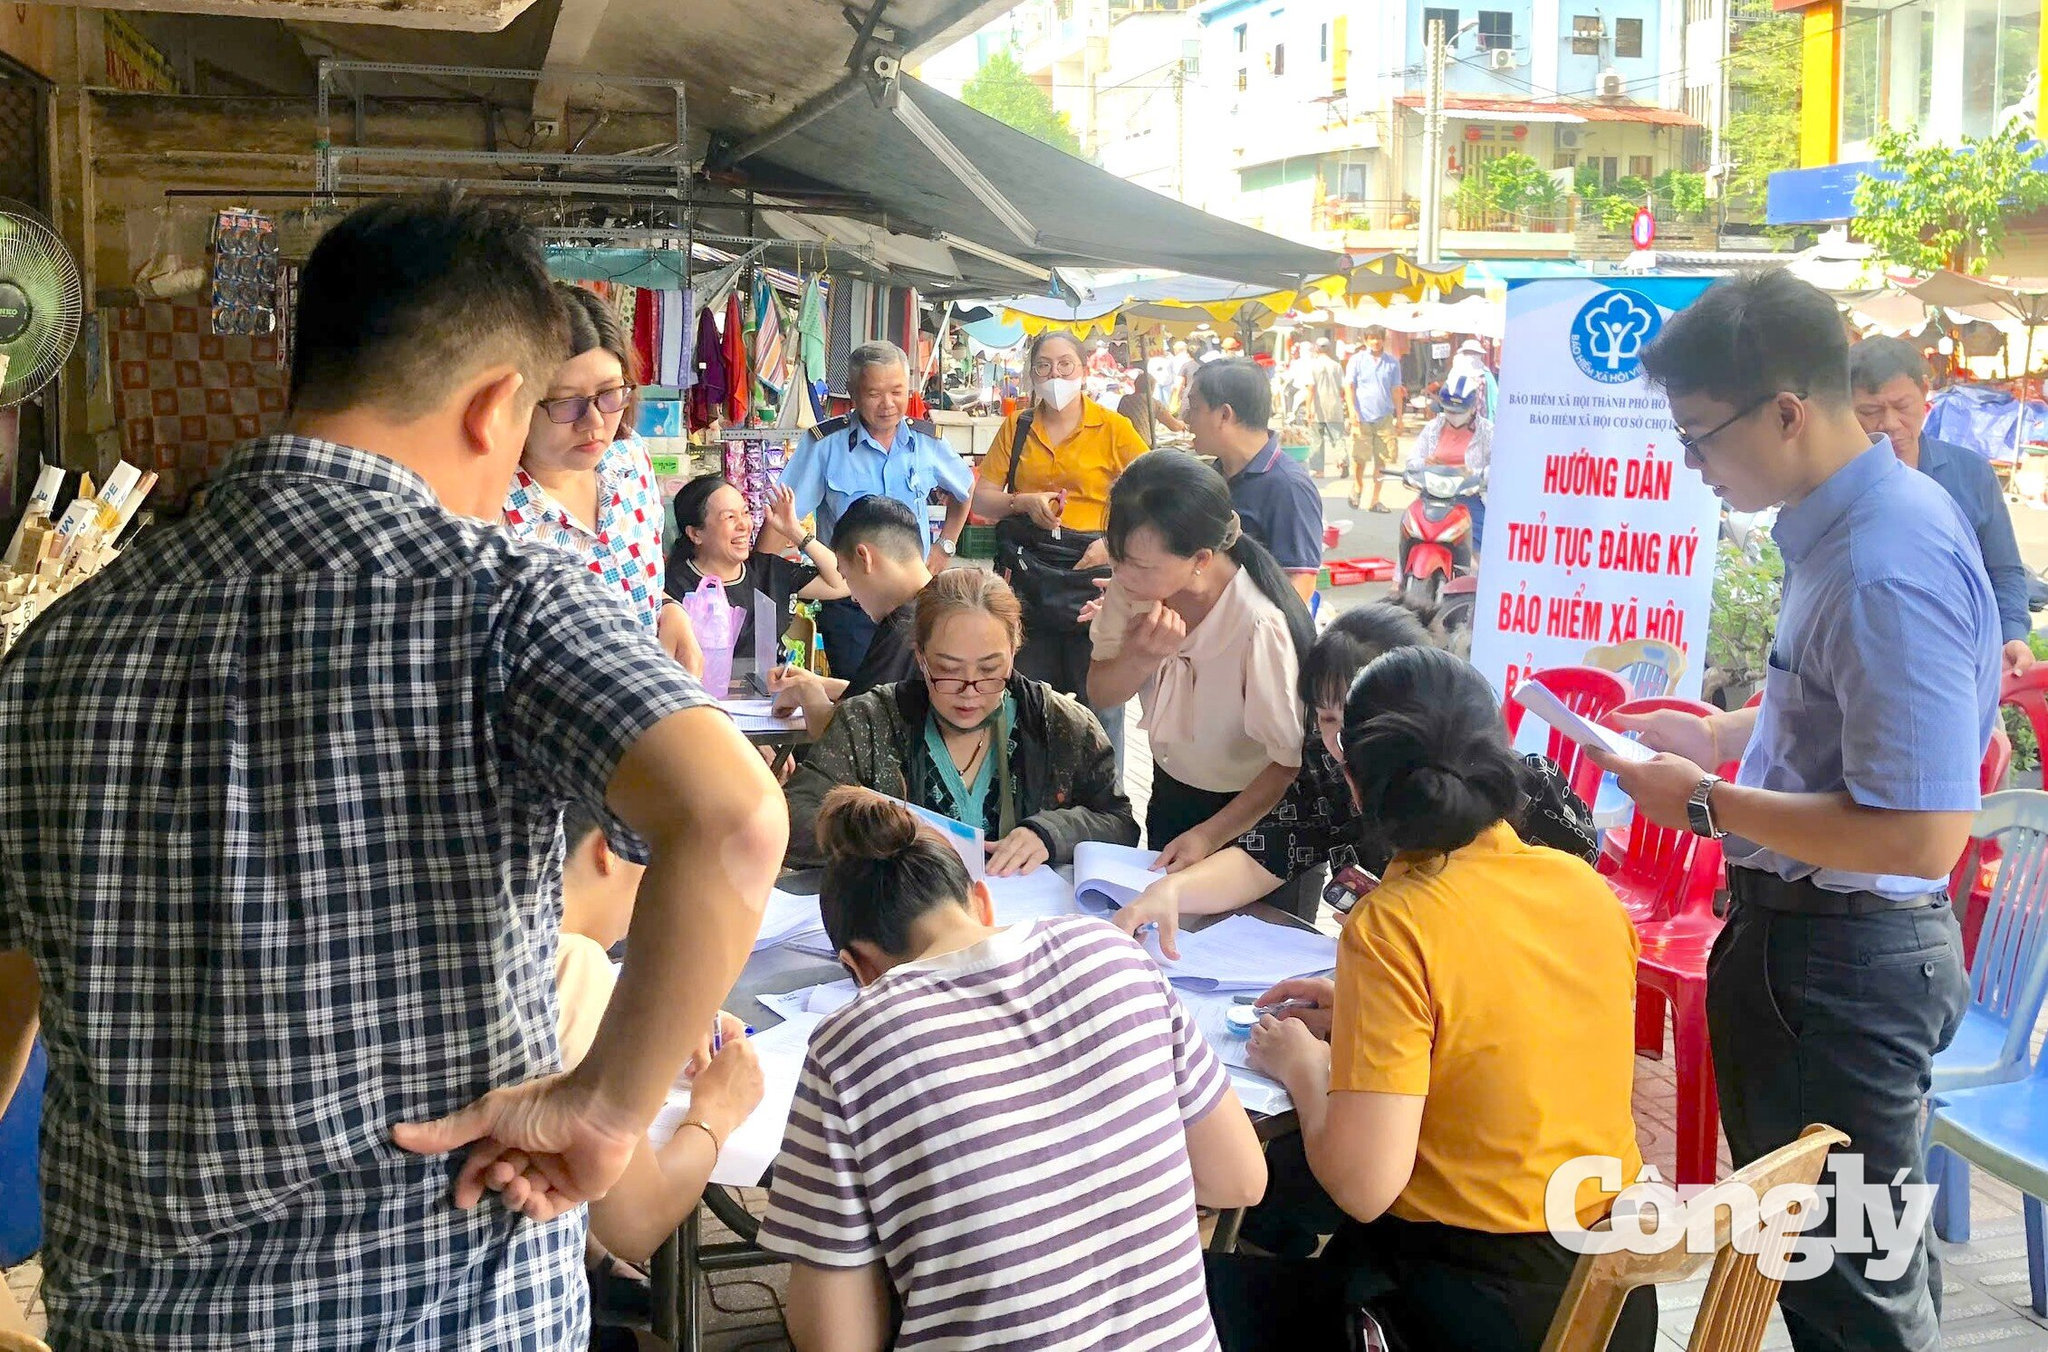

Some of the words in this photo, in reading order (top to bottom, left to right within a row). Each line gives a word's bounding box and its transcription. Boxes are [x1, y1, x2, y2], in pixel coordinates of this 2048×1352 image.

[1558, 393, 1570, 406] XÃ
[1592, 394, 1625, 409] THÀNH
[1578, 413, 1590, 426] XÃ
[1543, 448, 1618, 498] HƯỚNG
[1624, 444, 1673, 501] DẪN
[1507, 511, 1547, 564] THỦ
[1554, 526, 1592, 579] TỤC
[1598, 522, 1661, 576] ĐĂNG
[1666, 526, 1699, 578] KÝ
[1498, 580, 1541, 634] BẢO
[1547, 583, 1603, 642] HIỂM
[1608, 596, 1639, 644] XÃ
